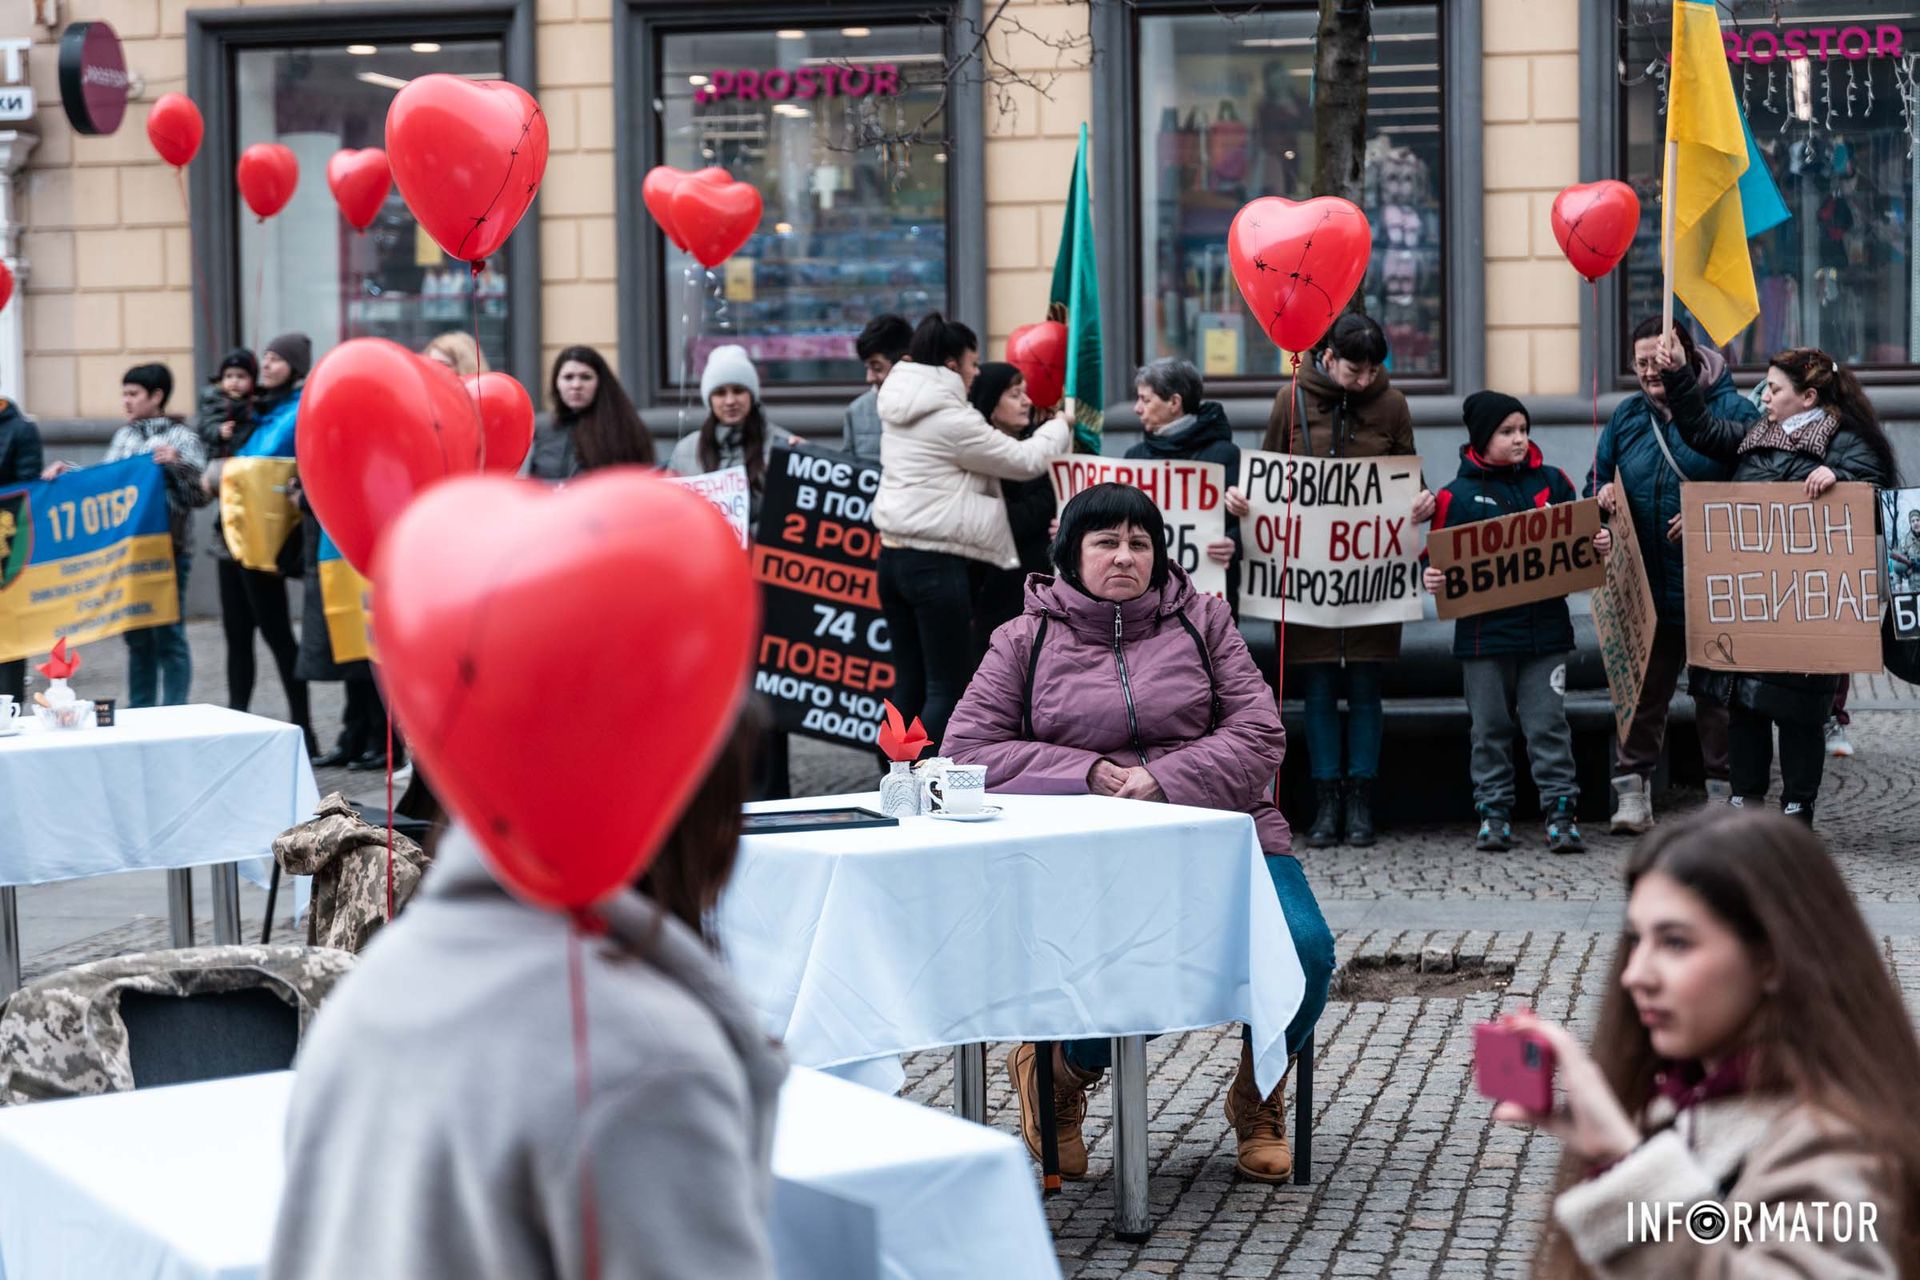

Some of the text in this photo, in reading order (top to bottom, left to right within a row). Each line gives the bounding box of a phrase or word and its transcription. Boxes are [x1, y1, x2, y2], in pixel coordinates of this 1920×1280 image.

[1722, 24, 1903, 65] ROSTOR
[787, 453, 853, 488] МОЄ
[1246, 457, 1382, 507] РОЗВІДКА
[48, 485, 138, 543] 17 ОТБР
[796, 485, 818, 510] В
[782, 513, 808, 543] 2
[1329, 515, 1405, 562] ВСІХ
[1453, 504, 1573, 561] ПОЛОН
[1704, 502, 1854, 555] ПОЛОН
[762, 553, 871, 599] ПОЛОН
[1248, 558, 1418, 606] ПІДРОЗДІЛІВ!
[813, 603, 856, 644] 74
[759, 634, 896, 692] ПОВЕР
[755, 670, 833, 708] МОГО
[802, 708, 881, 745] ДОДО
